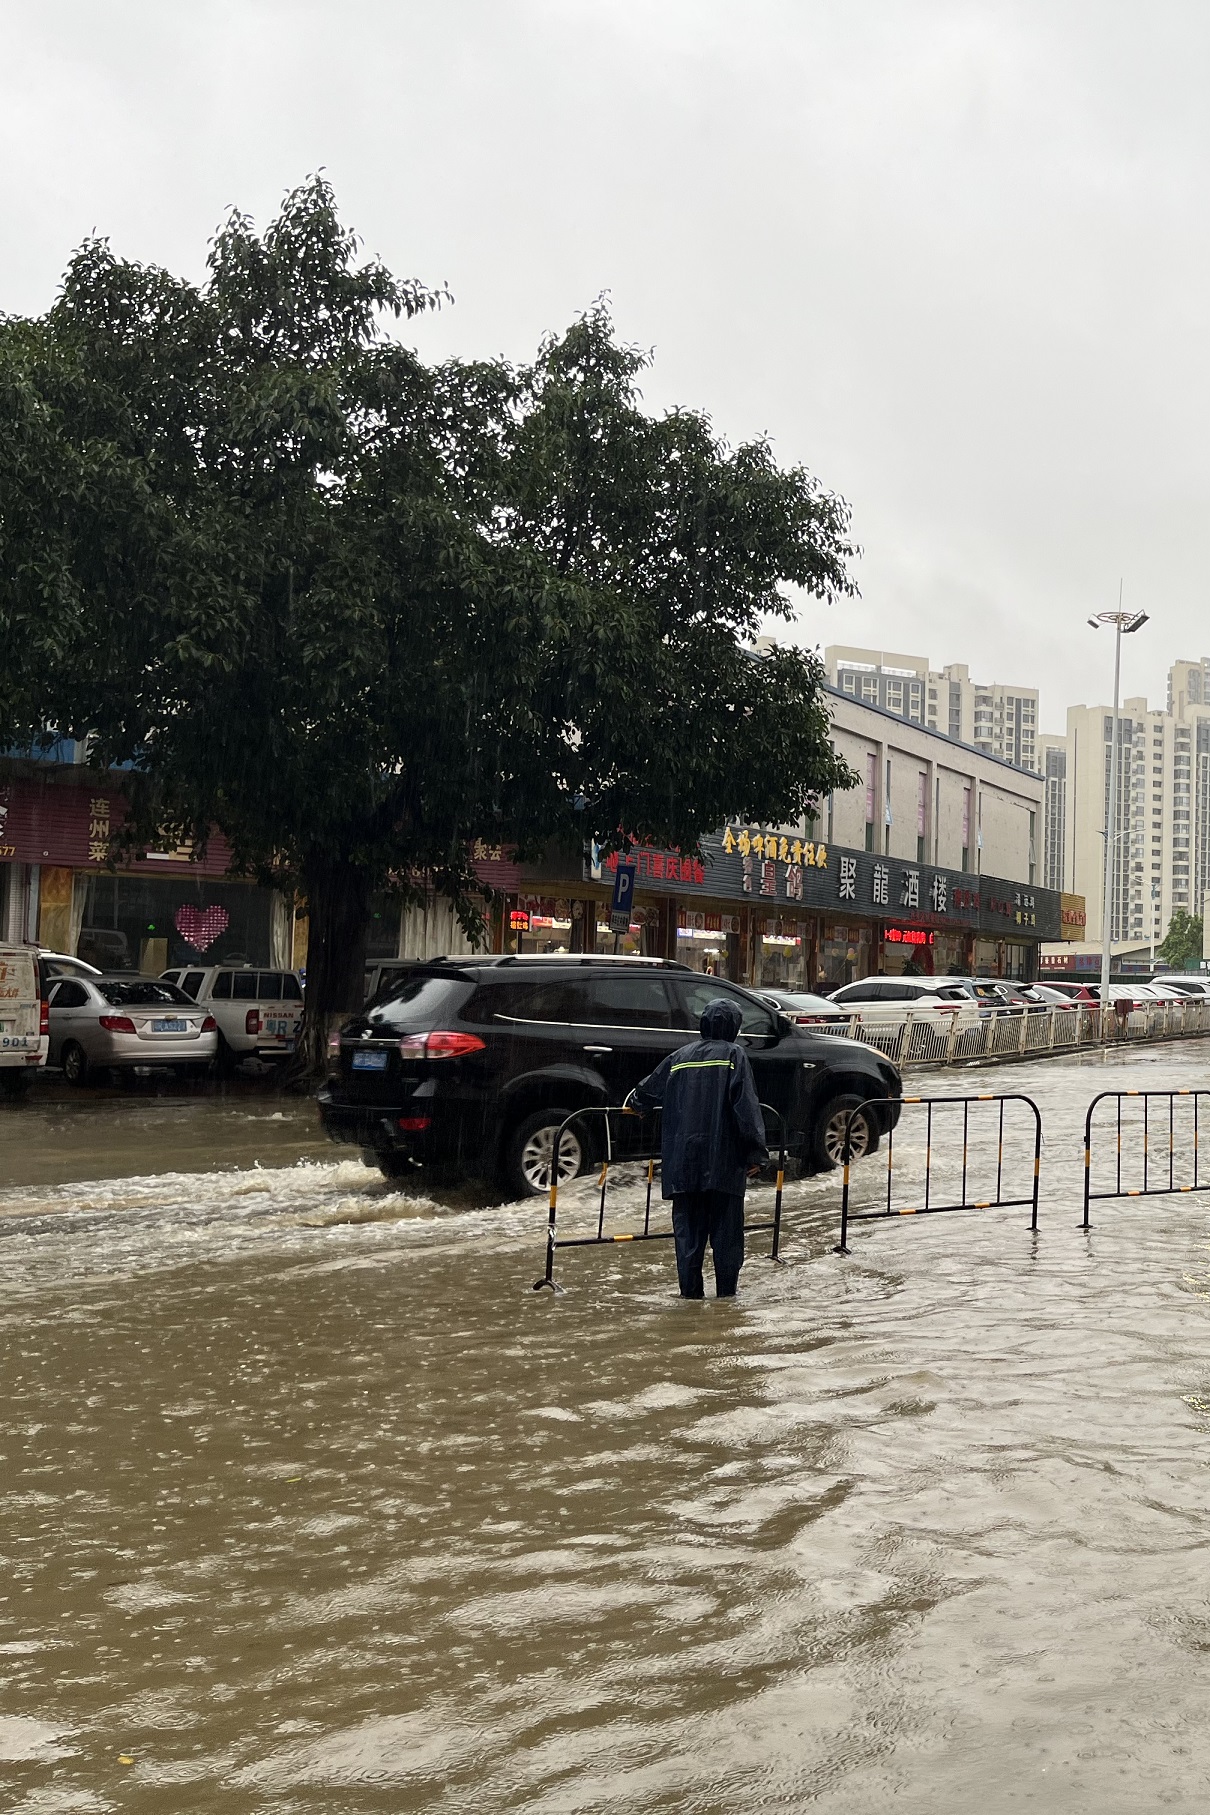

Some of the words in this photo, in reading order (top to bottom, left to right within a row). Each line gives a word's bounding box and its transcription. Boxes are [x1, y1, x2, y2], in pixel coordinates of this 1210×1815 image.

[88, 798, 111, 862] 连州菜
[617, 873, 629, 903] P
[839, 856, 948, 912] 聚龍酒楼
